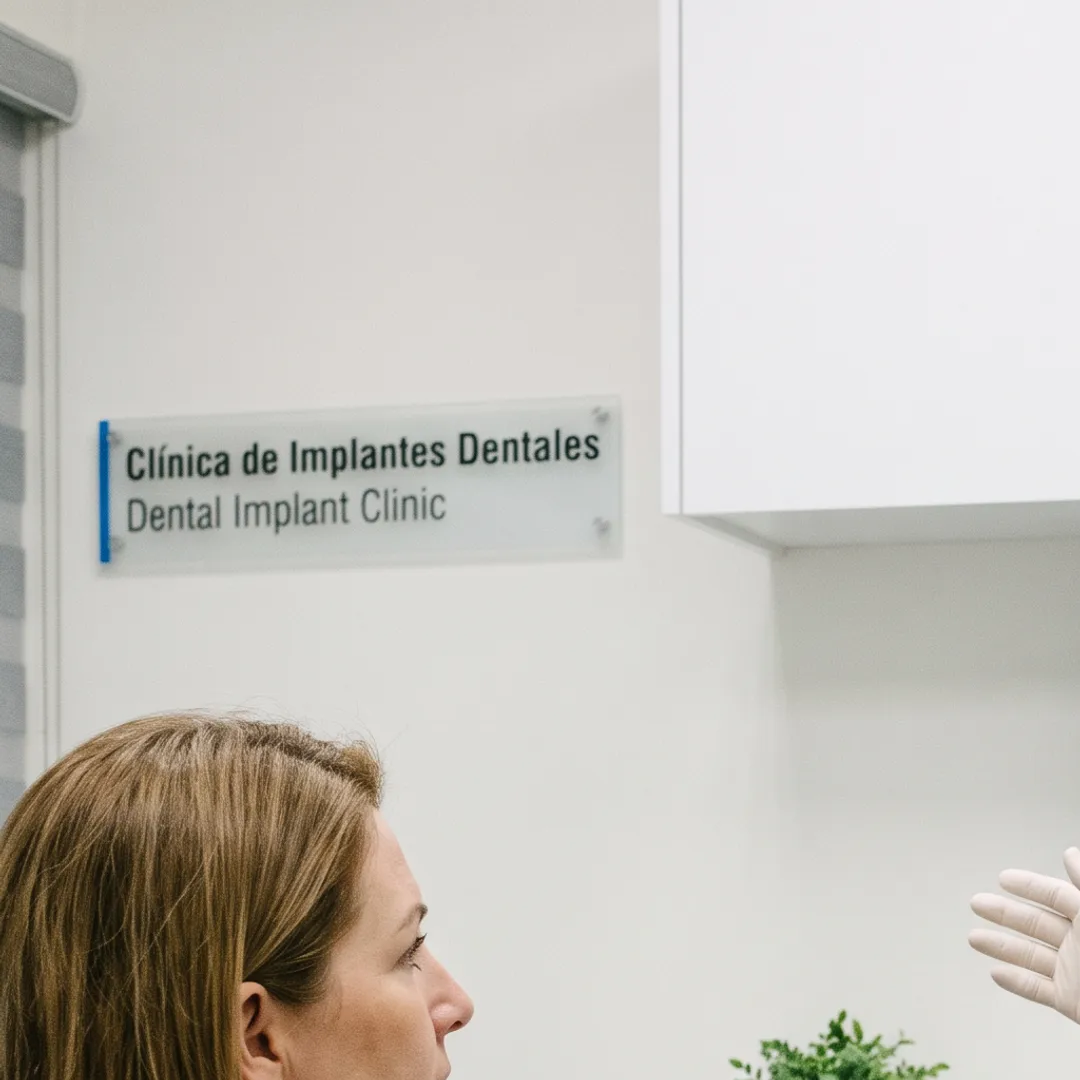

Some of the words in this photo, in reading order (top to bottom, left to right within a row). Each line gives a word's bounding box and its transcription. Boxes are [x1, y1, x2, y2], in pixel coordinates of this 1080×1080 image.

[125, 444, 231, 483] Clínica
[241, 441, 279, 477] de
[290, 436, 447, 481] Implantes
[457, 427, 601, 467] Dentales
[126, 494, 222, 534] Dental
[234, 490, 351, 536] Implant
[360, 486, 447, 524] Clinic
